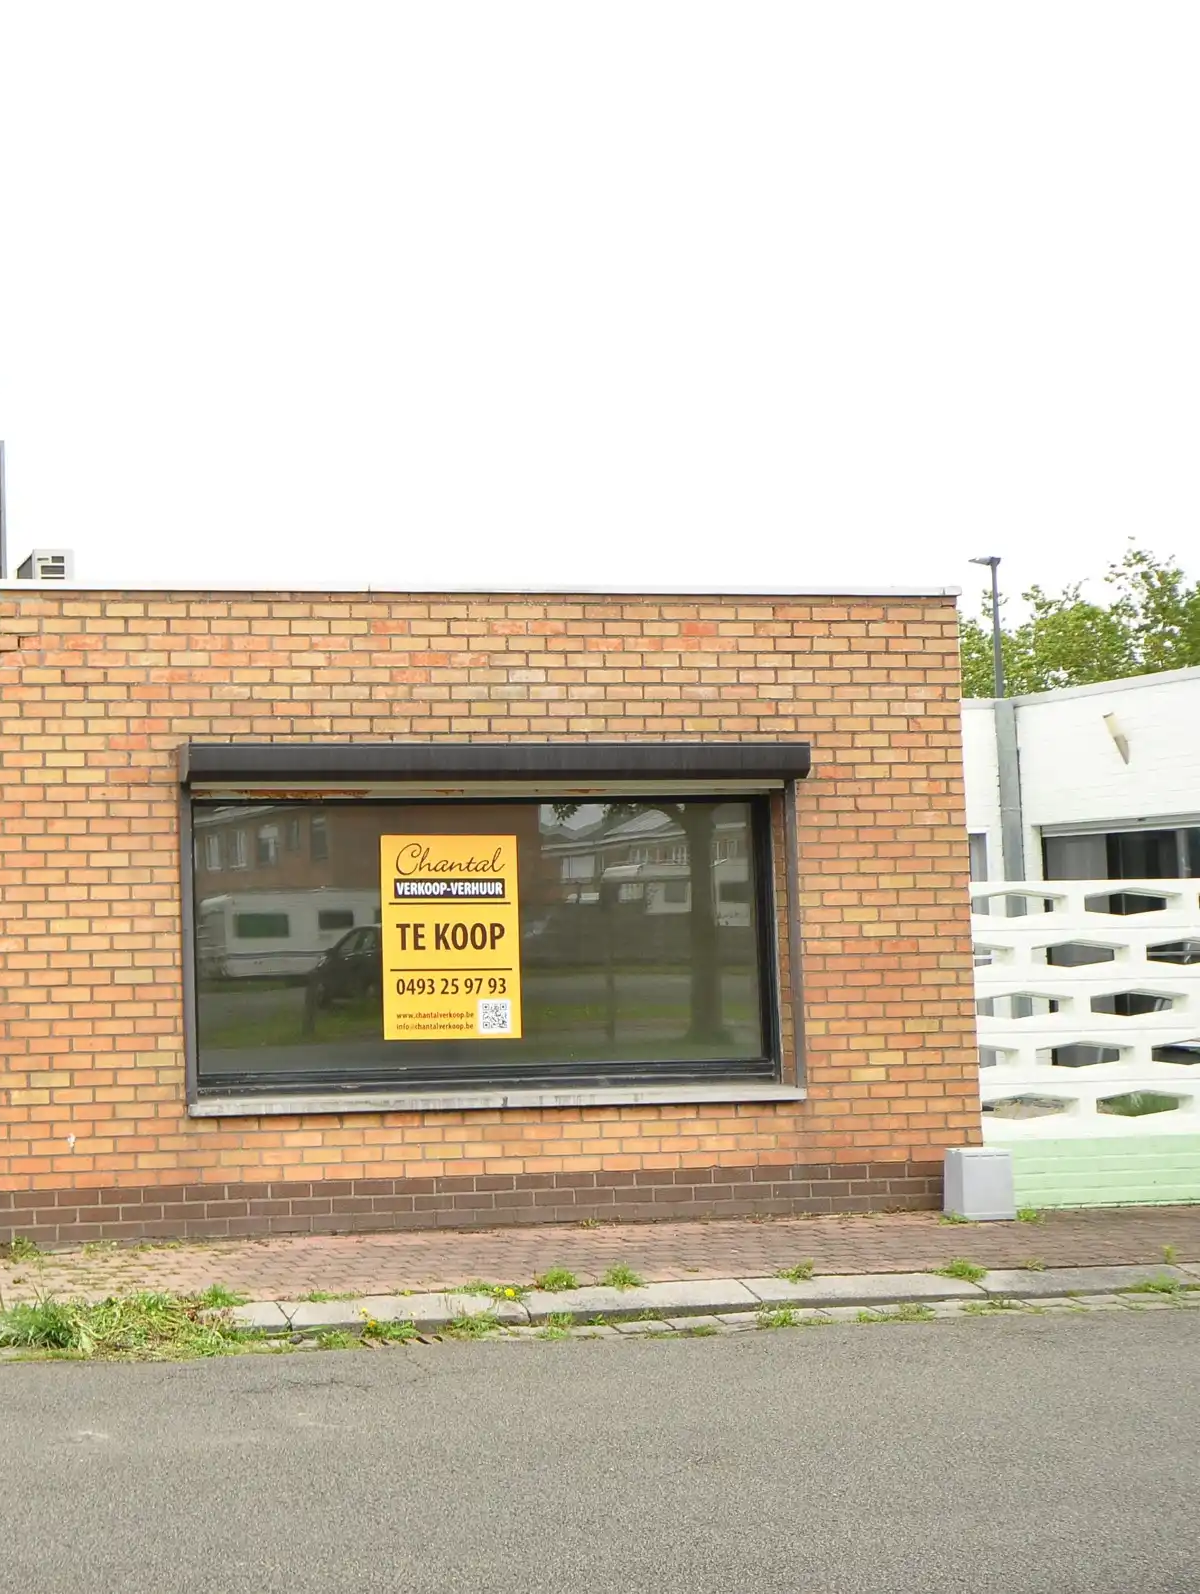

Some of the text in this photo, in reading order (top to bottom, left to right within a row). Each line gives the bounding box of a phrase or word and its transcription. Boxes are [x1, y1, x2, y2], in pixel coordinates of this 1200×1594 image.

[395, 843, 505, 876] Chantal
[396, 881, 503, 896] VERKOOP-VERHUUR
[396, 922, 505, 951] TE KOOP
[396, 977, 507, 995] 0493 25 97 93
[396, 1011, 474, 1020] www.chantalverkoop.be
